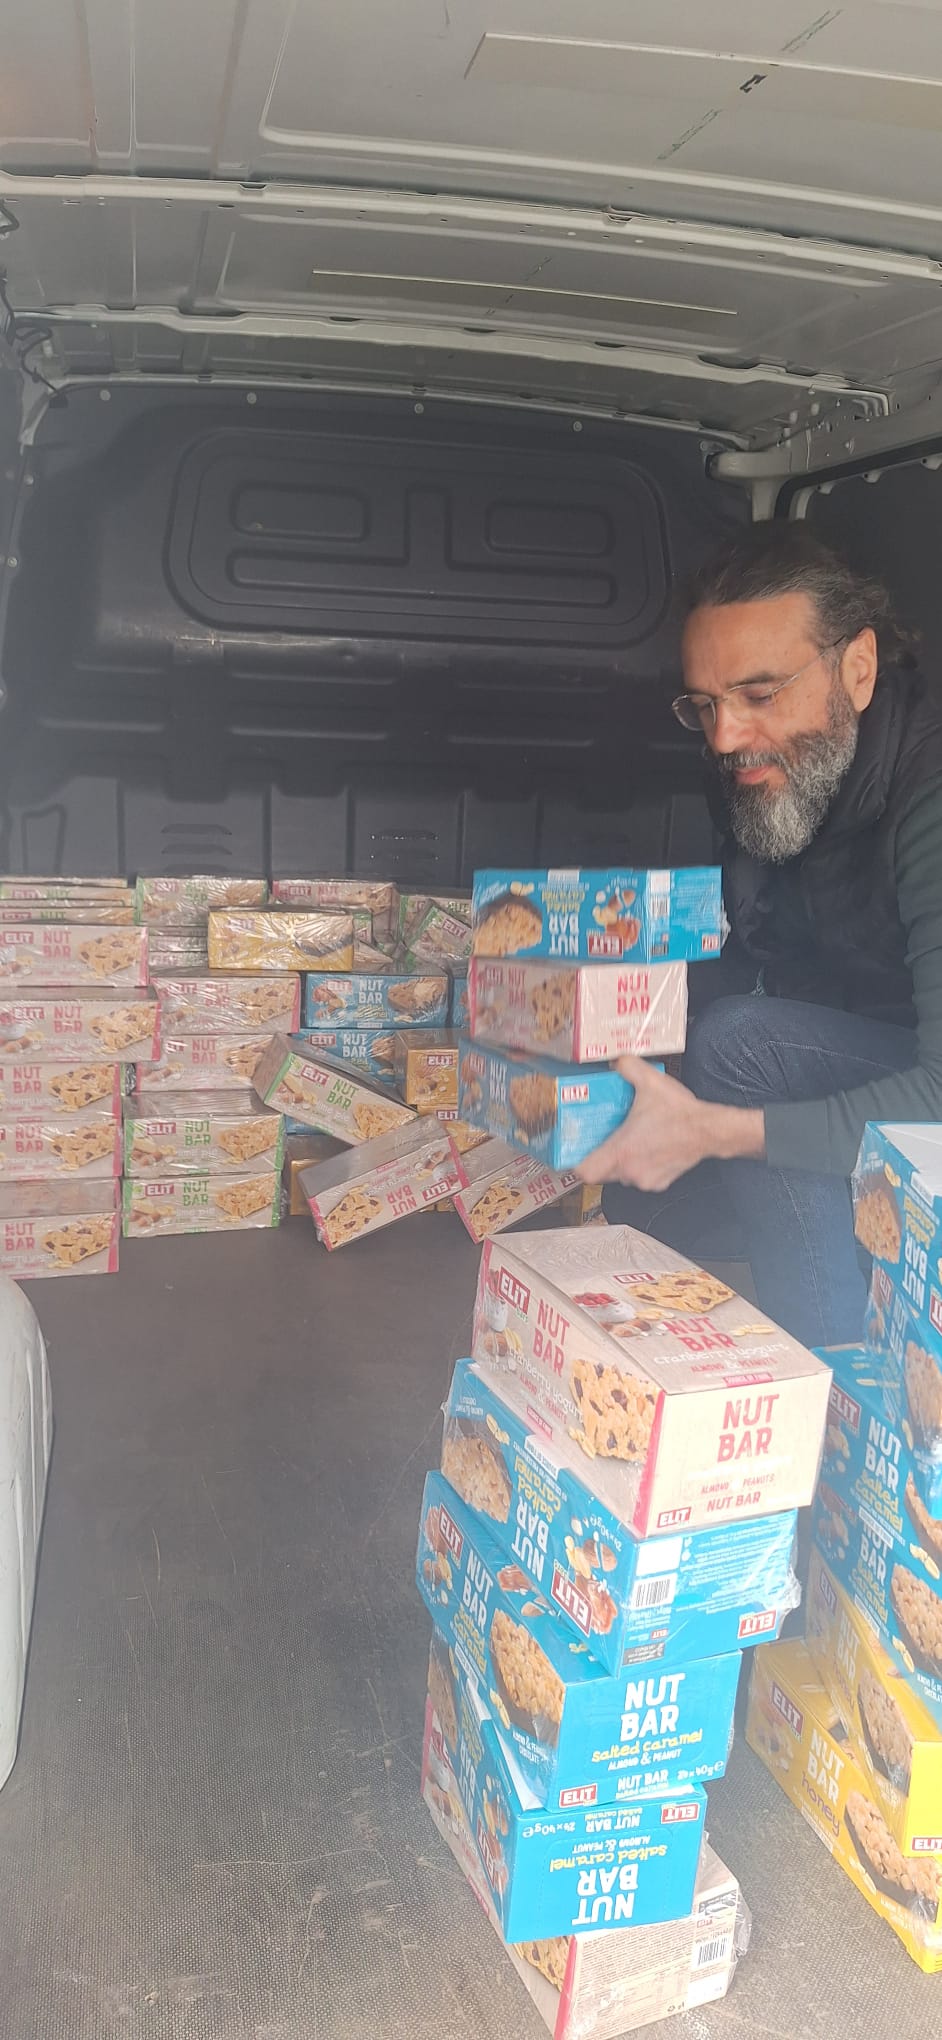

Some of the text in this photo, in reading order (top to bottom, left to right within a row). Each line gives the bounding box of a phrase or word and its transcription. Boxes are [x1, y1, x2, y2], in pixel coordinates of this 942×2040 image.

[549, 914, 579, 933] BAR
[43, 932, 71, 943] NUT
[549, 936, 579, 956] NUT
[43, 946, 71, 958] BAR
[360, 980, 383, 991] NUT
[617, 975, 650, 993] NUT
[359, 992, 383, 1003] BAR
[617, 997, 650, 1016] BAR
[54, 1006, 82, 1018] NUT
[54, 1021, 82, 1033] BAR
[192, 1039, 216, 1050] NUT
[344, 1034, 367, 1045] NUT
[192, 1053, 216, 1064] BAR
[343, 1046, 366, 1057] BAR
[13, 1066, 41, 1079] NUT
[13, 1081, 41, 1093] BAR
[332, 1080, 359, 1098] NUT
[327, 1091, 352, 1111] BAR
[16, 1126, 43, 1139] NUT
[184, 1121, 211, 1132] NUT
[16, 1140, 43, 1152] BAR
[184, 1134, 211, 1146] BAR
[183, 1181, 209, 1193] NUT
[387, 1185, 412, 1203] BAR
[528, 1174, 552, 1194] BAR
[183, 1195, 209, 1206] BAR
[534, 1185, 557, 1205] NUT
[392, 1197, 417, 1216] NUT
[5, 1223, 35, 1236] NUT
[5, 1237, 35, 1250] BAR
[905, 1232, 927, 1282] BAR
[902, 1264, 924, 1310] NUT
[537, 1299, 570, 1345] NUT
[662, 1317, 718, 1335] NUT
[533, 1327, 565, 1377] BAR
[678, 1334, 738, 1352] BAR
[654, 1343, 789, 1365] cranberry yogurt
[691, 1362, 724, 1373] ALMOND
[726, 1359, 739, 1370] &
[509, 1347, 551, 1391] cranberry
[552, 1385, 584, 1422] yogurt
[723, 1394, 779, 1430] NUT
[717, 1427, 772, 1463] BAR
[868, 1415, 902, 1465] NUT
[865, 1443, 899, 1493] BAR
[701, 1473, 775, 1494] ALMOND PEANUTS
[707, 1491, 761, 1512] NUT BAR
[517, 1496, 549, 1553] BAR
[512, 1527, 544, 1581] NUT
[860, 1535, 887, 1586] BAR
[466, 1550, 493, 1603] NUT
[462, 1576, 487, 1633] BAR
[840, 1608, 859, 1658] NUT
[838, 1639, 856, 1681] BAR
[625, 1673, 685, 1711] NUT
[620, 1705, 679, 1741] BAR
[592, 1729, 703, 1762] salted caramel
[811, 1728, 844, 1780] NUT
[608, 1749, 682, 1770] ALMOND & PEANUT
[618, 1774, 642, 1790] NUT
[644, 1770, 669, 1784] BAR
[807, 1751, 839, 1807] BAR
[802, 1770, 840, 1837] honey
[586, 1818, 613, 1833] BAR
[614, 1815, 641, 1829] NUT
[572, 1835, 651, 1854] ALMOND & PEANUT
[549, 1845, 668, 1873] salted caramel
[577, 1863, 639, 1896] BAR
[572, 1892, 635, 1926] NUT
